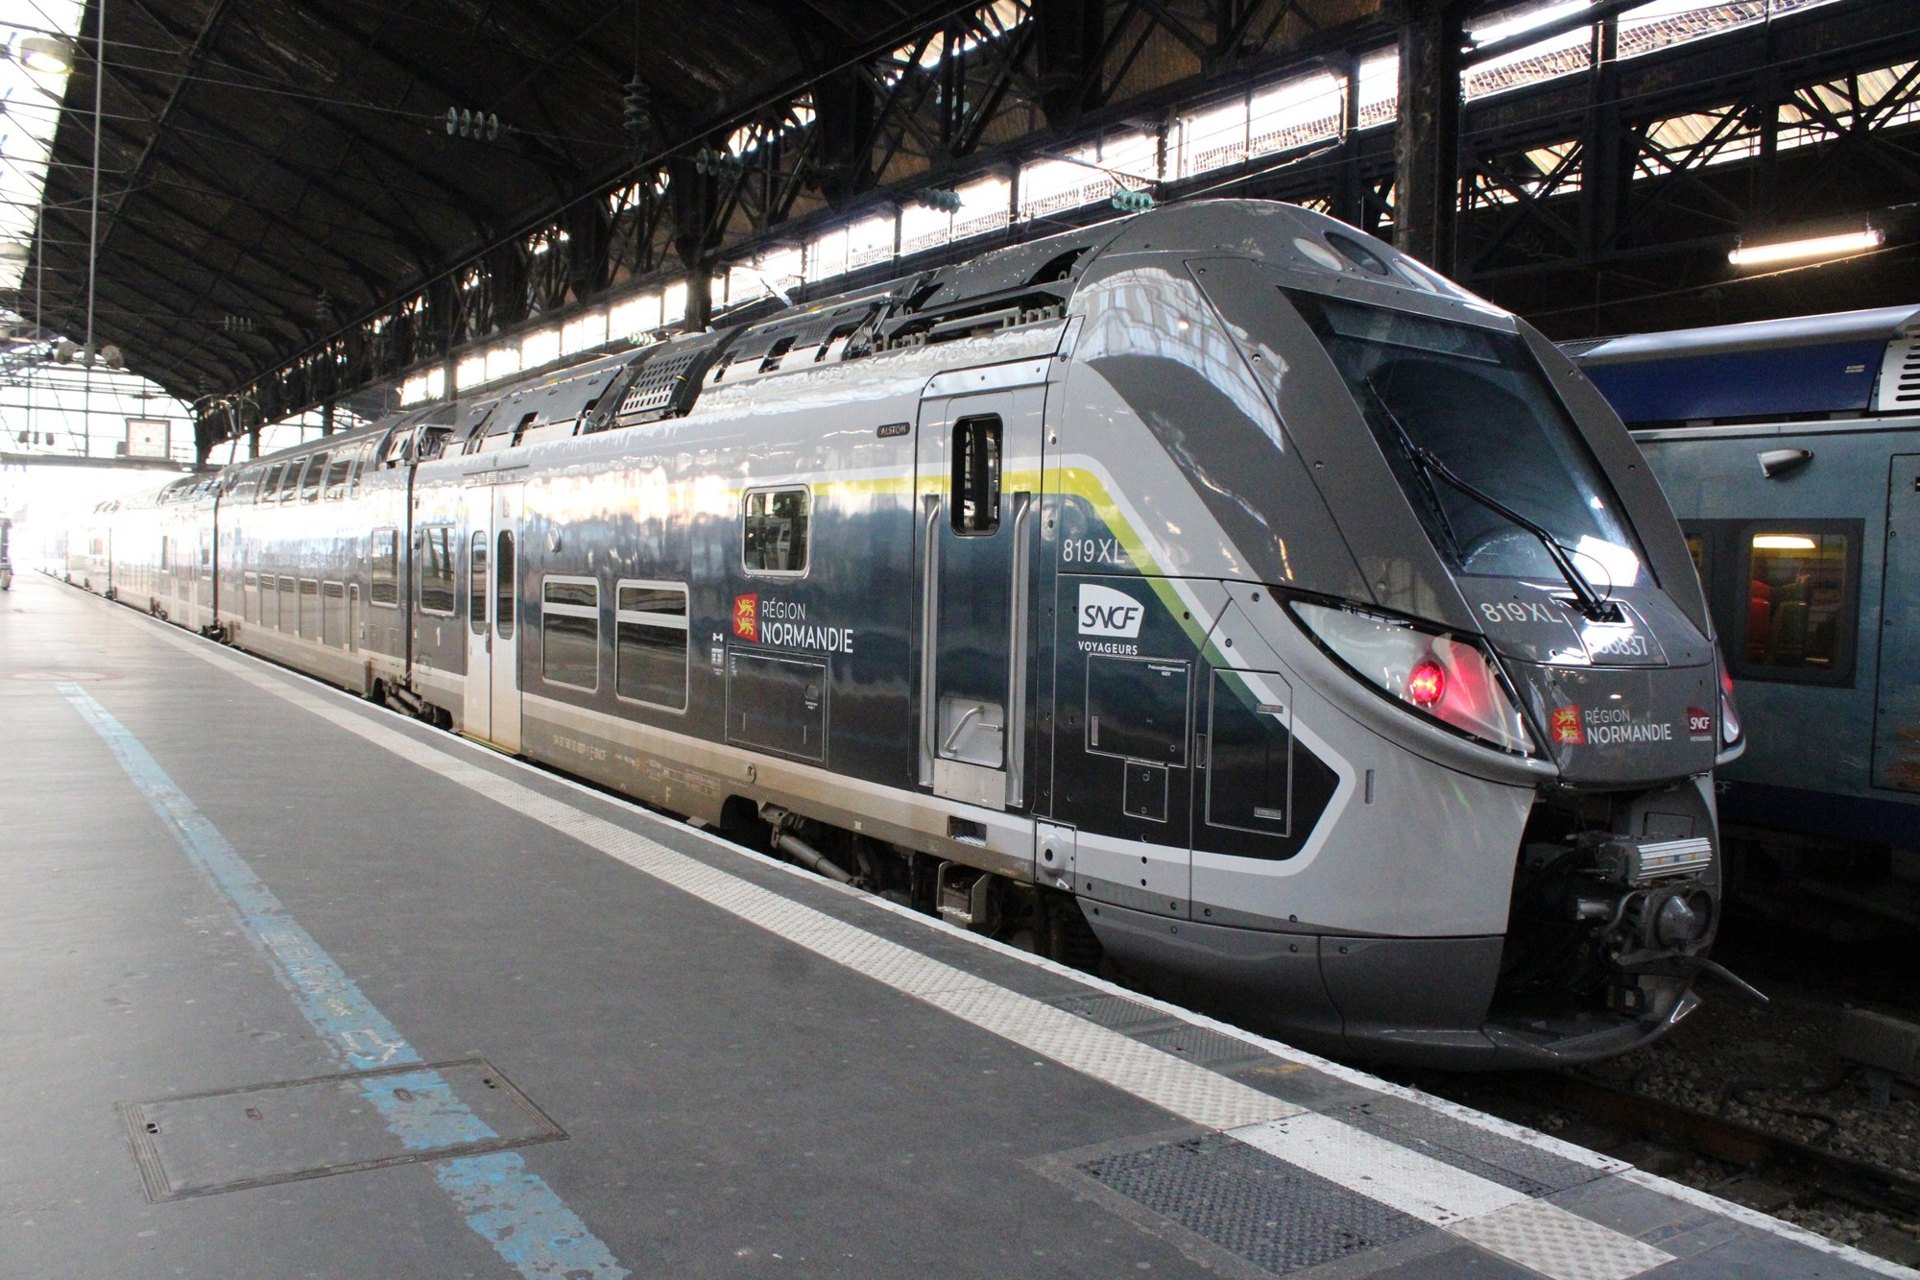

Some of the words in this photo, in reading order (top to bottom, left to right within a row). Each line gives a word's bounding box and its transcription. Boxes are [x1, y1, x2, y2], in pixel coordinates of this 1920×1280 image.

[880, 424, 907, 436] ALSTOM
[1063, 538, 1126, 564] 819XL
[762, 597, 806, 621] RÉGION
[1082, 604, 1139, 630] SNCF
[1481, 602, 1563, 623] 819XL
[761, 621, 854, 653] NORMANDIE
[1078, 641, 1138, 655] VOYAGEURS
[1585, 707, 1631, 724] RÉGION
[1690, 717, 1710, 730] SNCF
[1587, 723, 1673, 744] NORMANDIE
